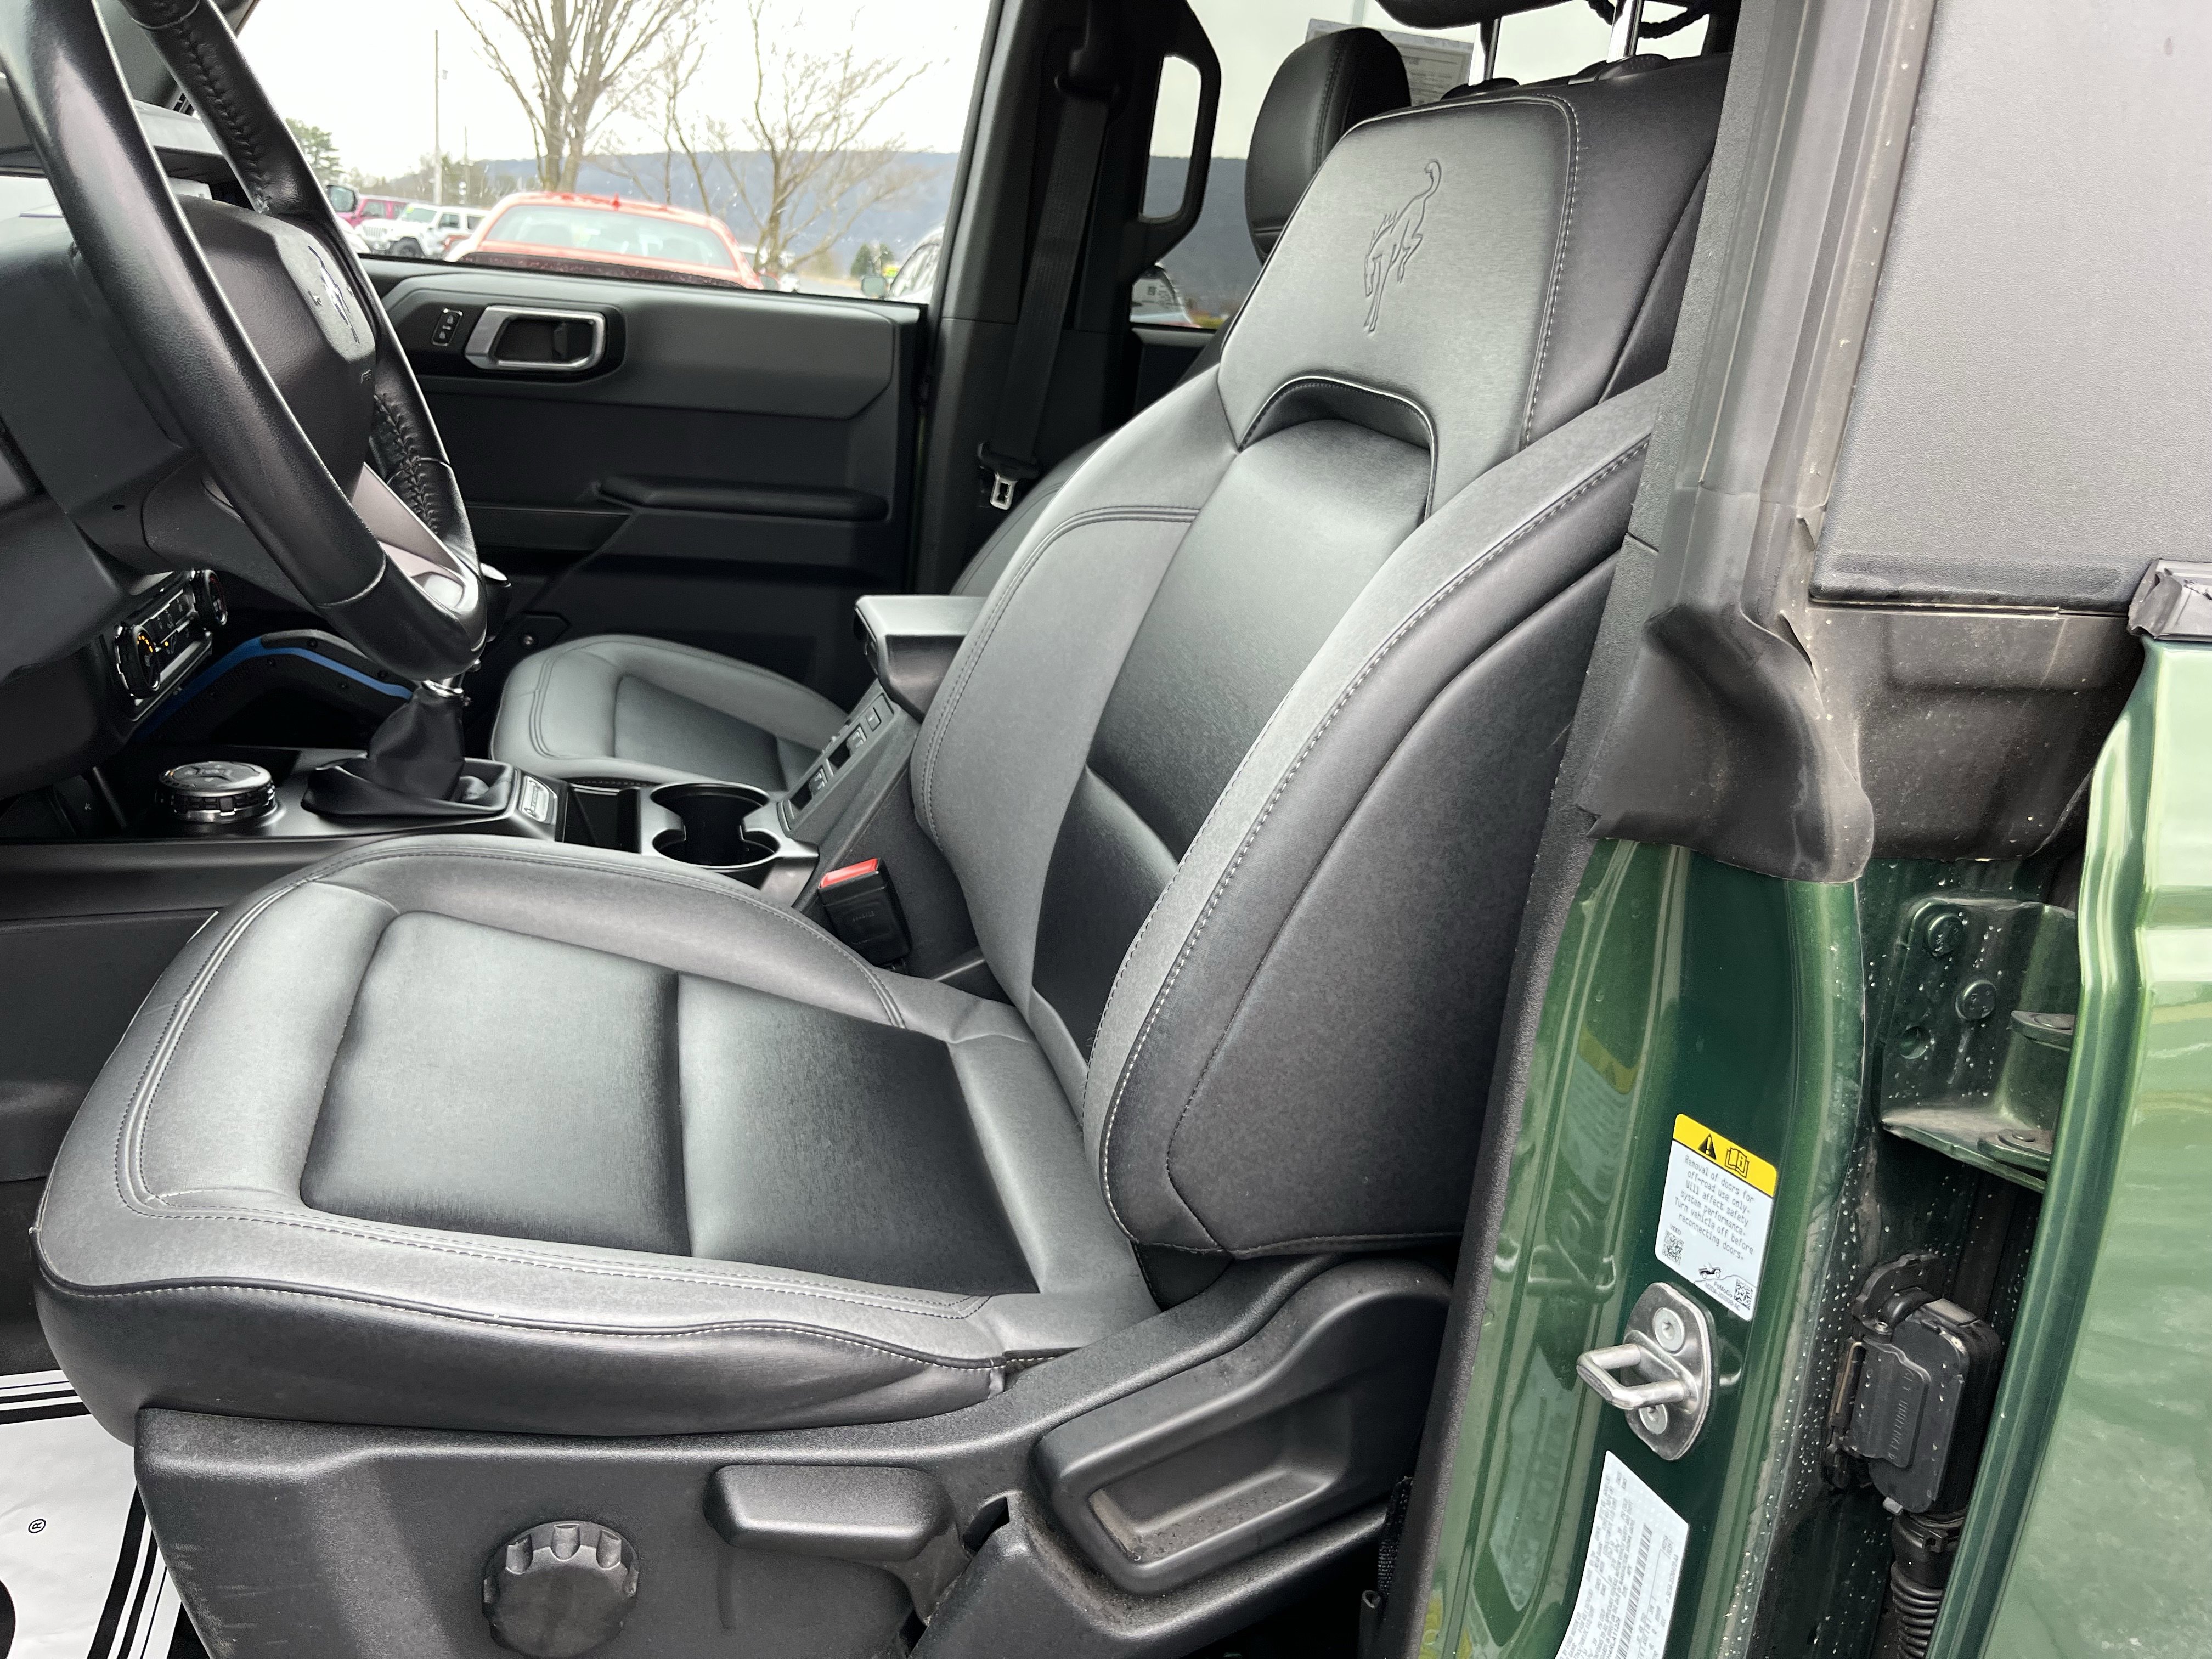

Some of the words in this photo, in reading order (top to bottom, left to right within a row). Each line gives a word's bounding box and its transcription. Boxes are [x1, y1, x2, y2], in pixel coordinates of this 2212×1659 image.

[1684, 1154, 1708, 1176] Removal
[1711, 1171, 1718, 1182] of
[1720, 1177, 1739, 1194] doors
[1742, 1190, 1754, 1204] for
[1687, 1169, 1716, 1193] off-road
[1718, 1189, 1729, 1201] use
[1731, 1196, 1750, 1216] only.
[1674, 1197, 1688, 1212] Turn
[1690, 1207, 1715, 1229] vehicle
[1717, 1224, 1728, 1238] off
[1730, 1233, 1754, 1255] before
[1680, 1189, 1701, 1210] system
[1703, 1205, 1746, 1236] performance.
[1685, 1179, 1699, 1195] Will
[1702, 1190, 1724, 1210] affect
[1726, 1205, 1748, 1228] safety
[1669, 1223, 1681, 1235] VIDEO
[1678, 1212, 1720, 1246] reconnecting
[1722, 1240, 1744, 1260] doors.
[1713, 1281, 1733, 1298] FoMoCo
